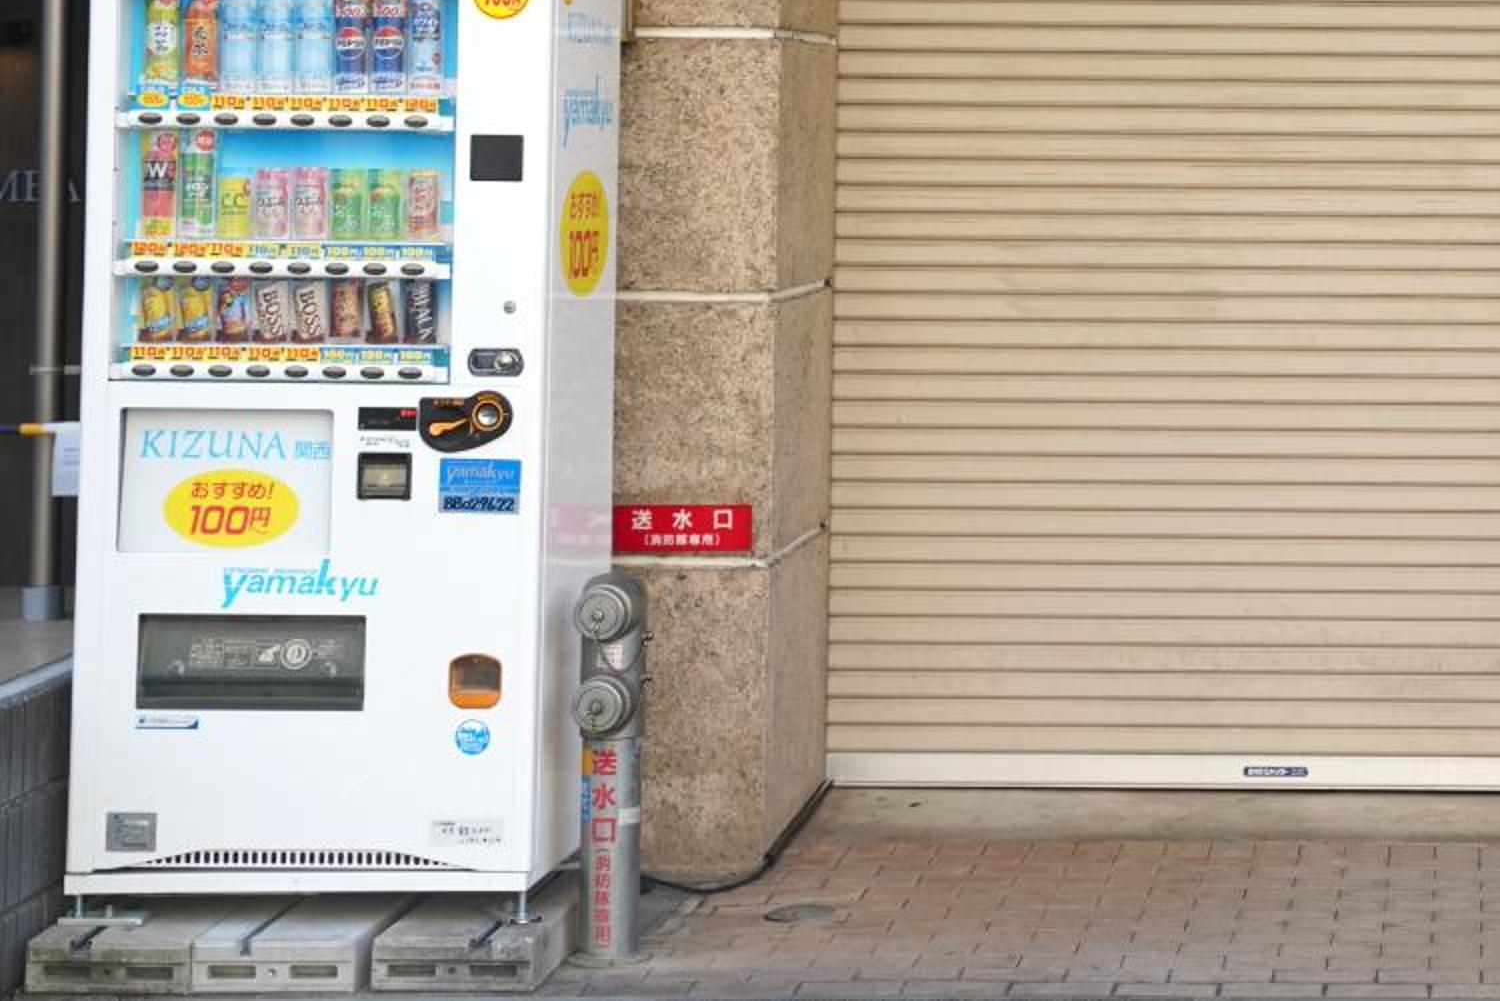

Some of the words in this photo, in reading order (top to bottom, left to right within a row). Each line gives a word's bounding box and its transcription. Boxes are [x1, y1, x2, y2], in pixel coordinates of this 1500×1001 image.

[262, 289, 284, 337] BOSS
[300, 289, 322, 337] BOSS
[141, 429, 287, 459] KIZUNA
[190, 505, 272, 535] 100円
[632, 509, 734, 530] 送水口
[221, 559, 379, 609] yamakyu
[592, 748, 617, 843] 送水口
